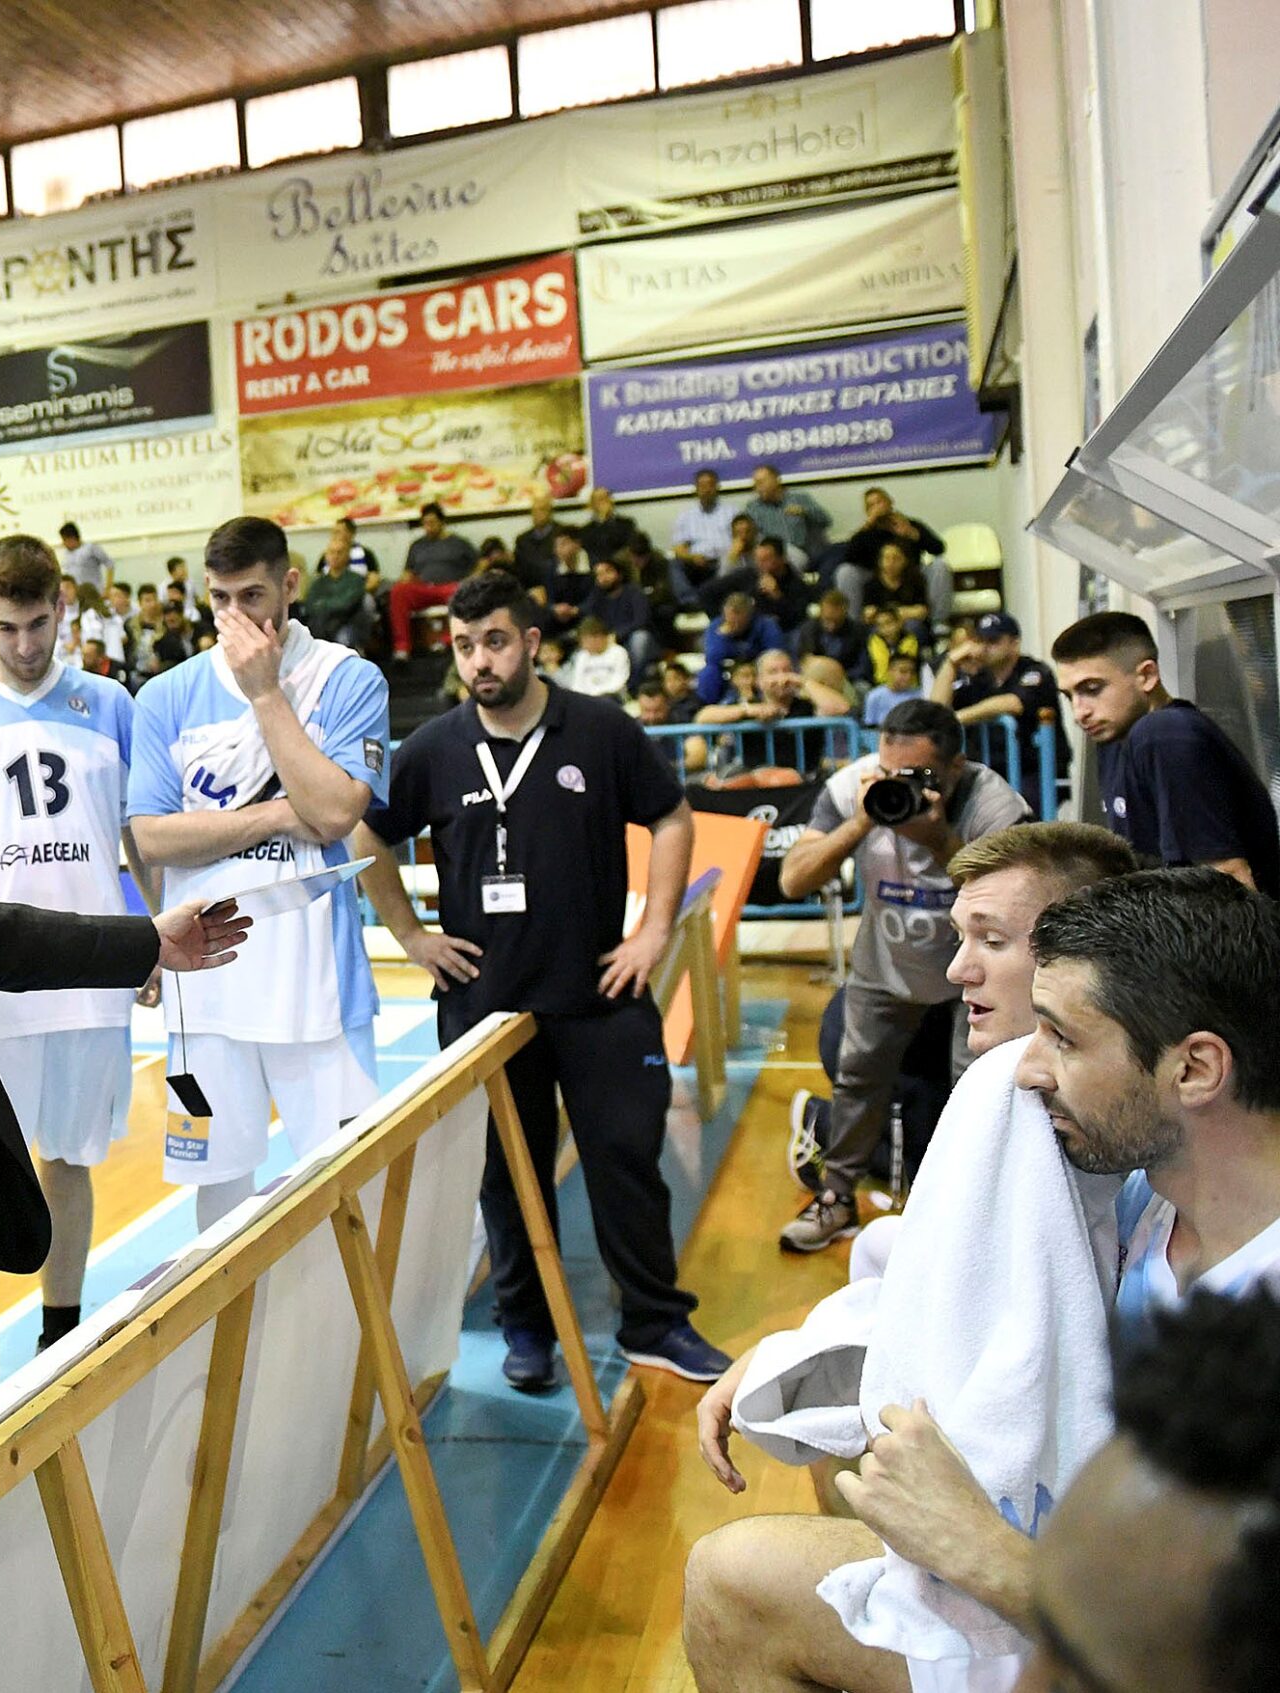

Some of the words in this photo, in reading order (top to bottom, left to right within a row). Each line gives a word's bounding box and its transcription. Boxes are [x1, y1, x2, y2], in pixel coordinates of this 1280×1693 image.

[267, 168, 486, 241] Bellevue
[320, 230, 439, 276] Suites
[240, 298, 409, 368] RODOS
[422, 271, 568, 342] CARS
[245, 373, 302, 400] RENT
[305, 370, 321, 393] A
[324, 363, 370, 389] CAR
[598, 382, 621, 409] K
[624, 373, 740, 405] Building
[615, 388, 836, 437] ΚΑΤΑΣΚΕΥΑΣΤΙΚΕΣ
[838, 374, 960, 411] ΕΡΓΑΣΙΕΣ
[22, 447, 119, 478] ATRIUM
[3, 748, 73, 820] 13
[461, 788, 494, 806] FILA
[31, 841, 90, 865] AEGEAN
[186, 1139, 205, 1151] Star
